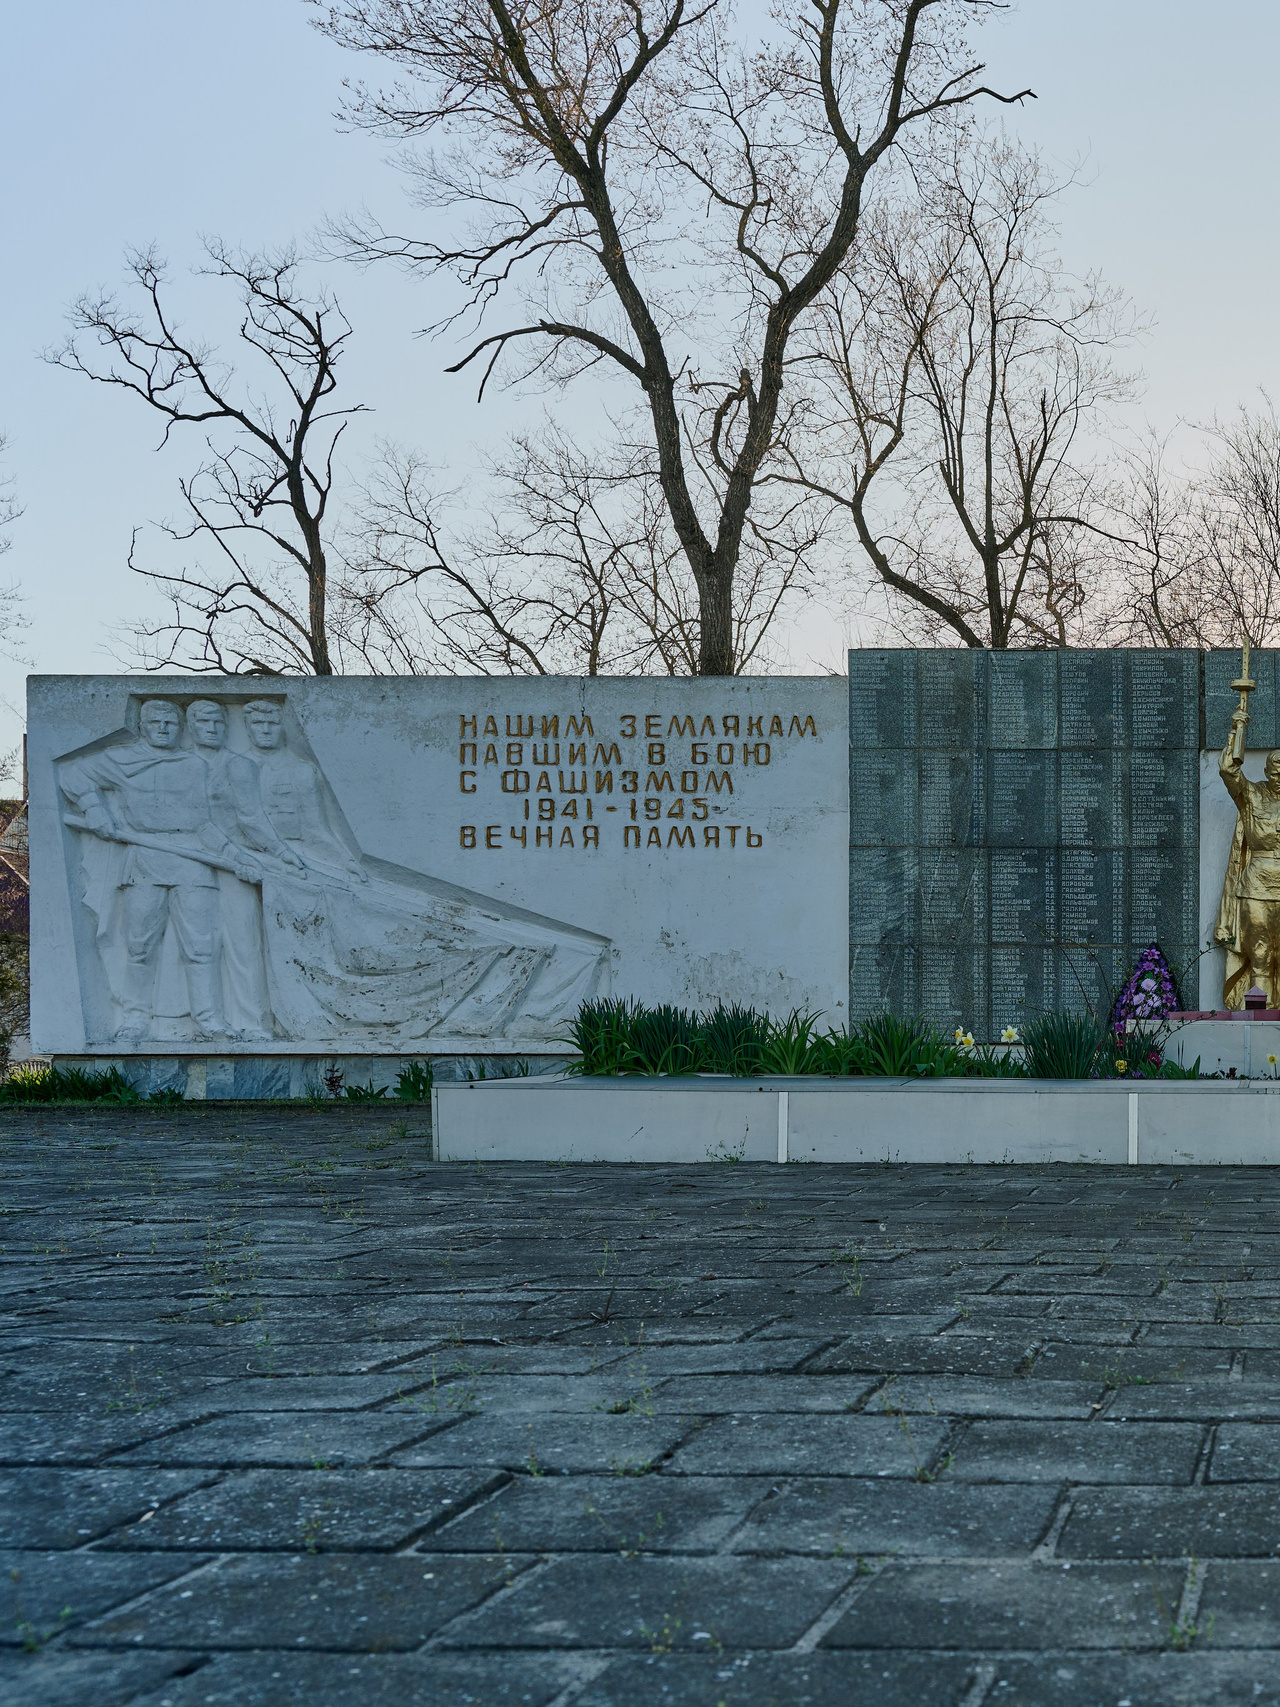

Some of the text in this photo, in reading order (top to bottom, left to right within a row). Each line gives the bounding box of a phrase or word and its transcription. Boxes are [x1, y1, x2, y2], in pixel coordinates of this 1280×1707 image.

[460, 714, 818, 738] НАШИМ ЗЕМЛЯКАМ
[459, 743, 771, 766] ПАВШИМ В БОЮ
[460, 769, 733, 795] С ФАШИЗМОМ
[460, 826, 763, 850] ВЕЧНАЯ ПАМЯТЬ
